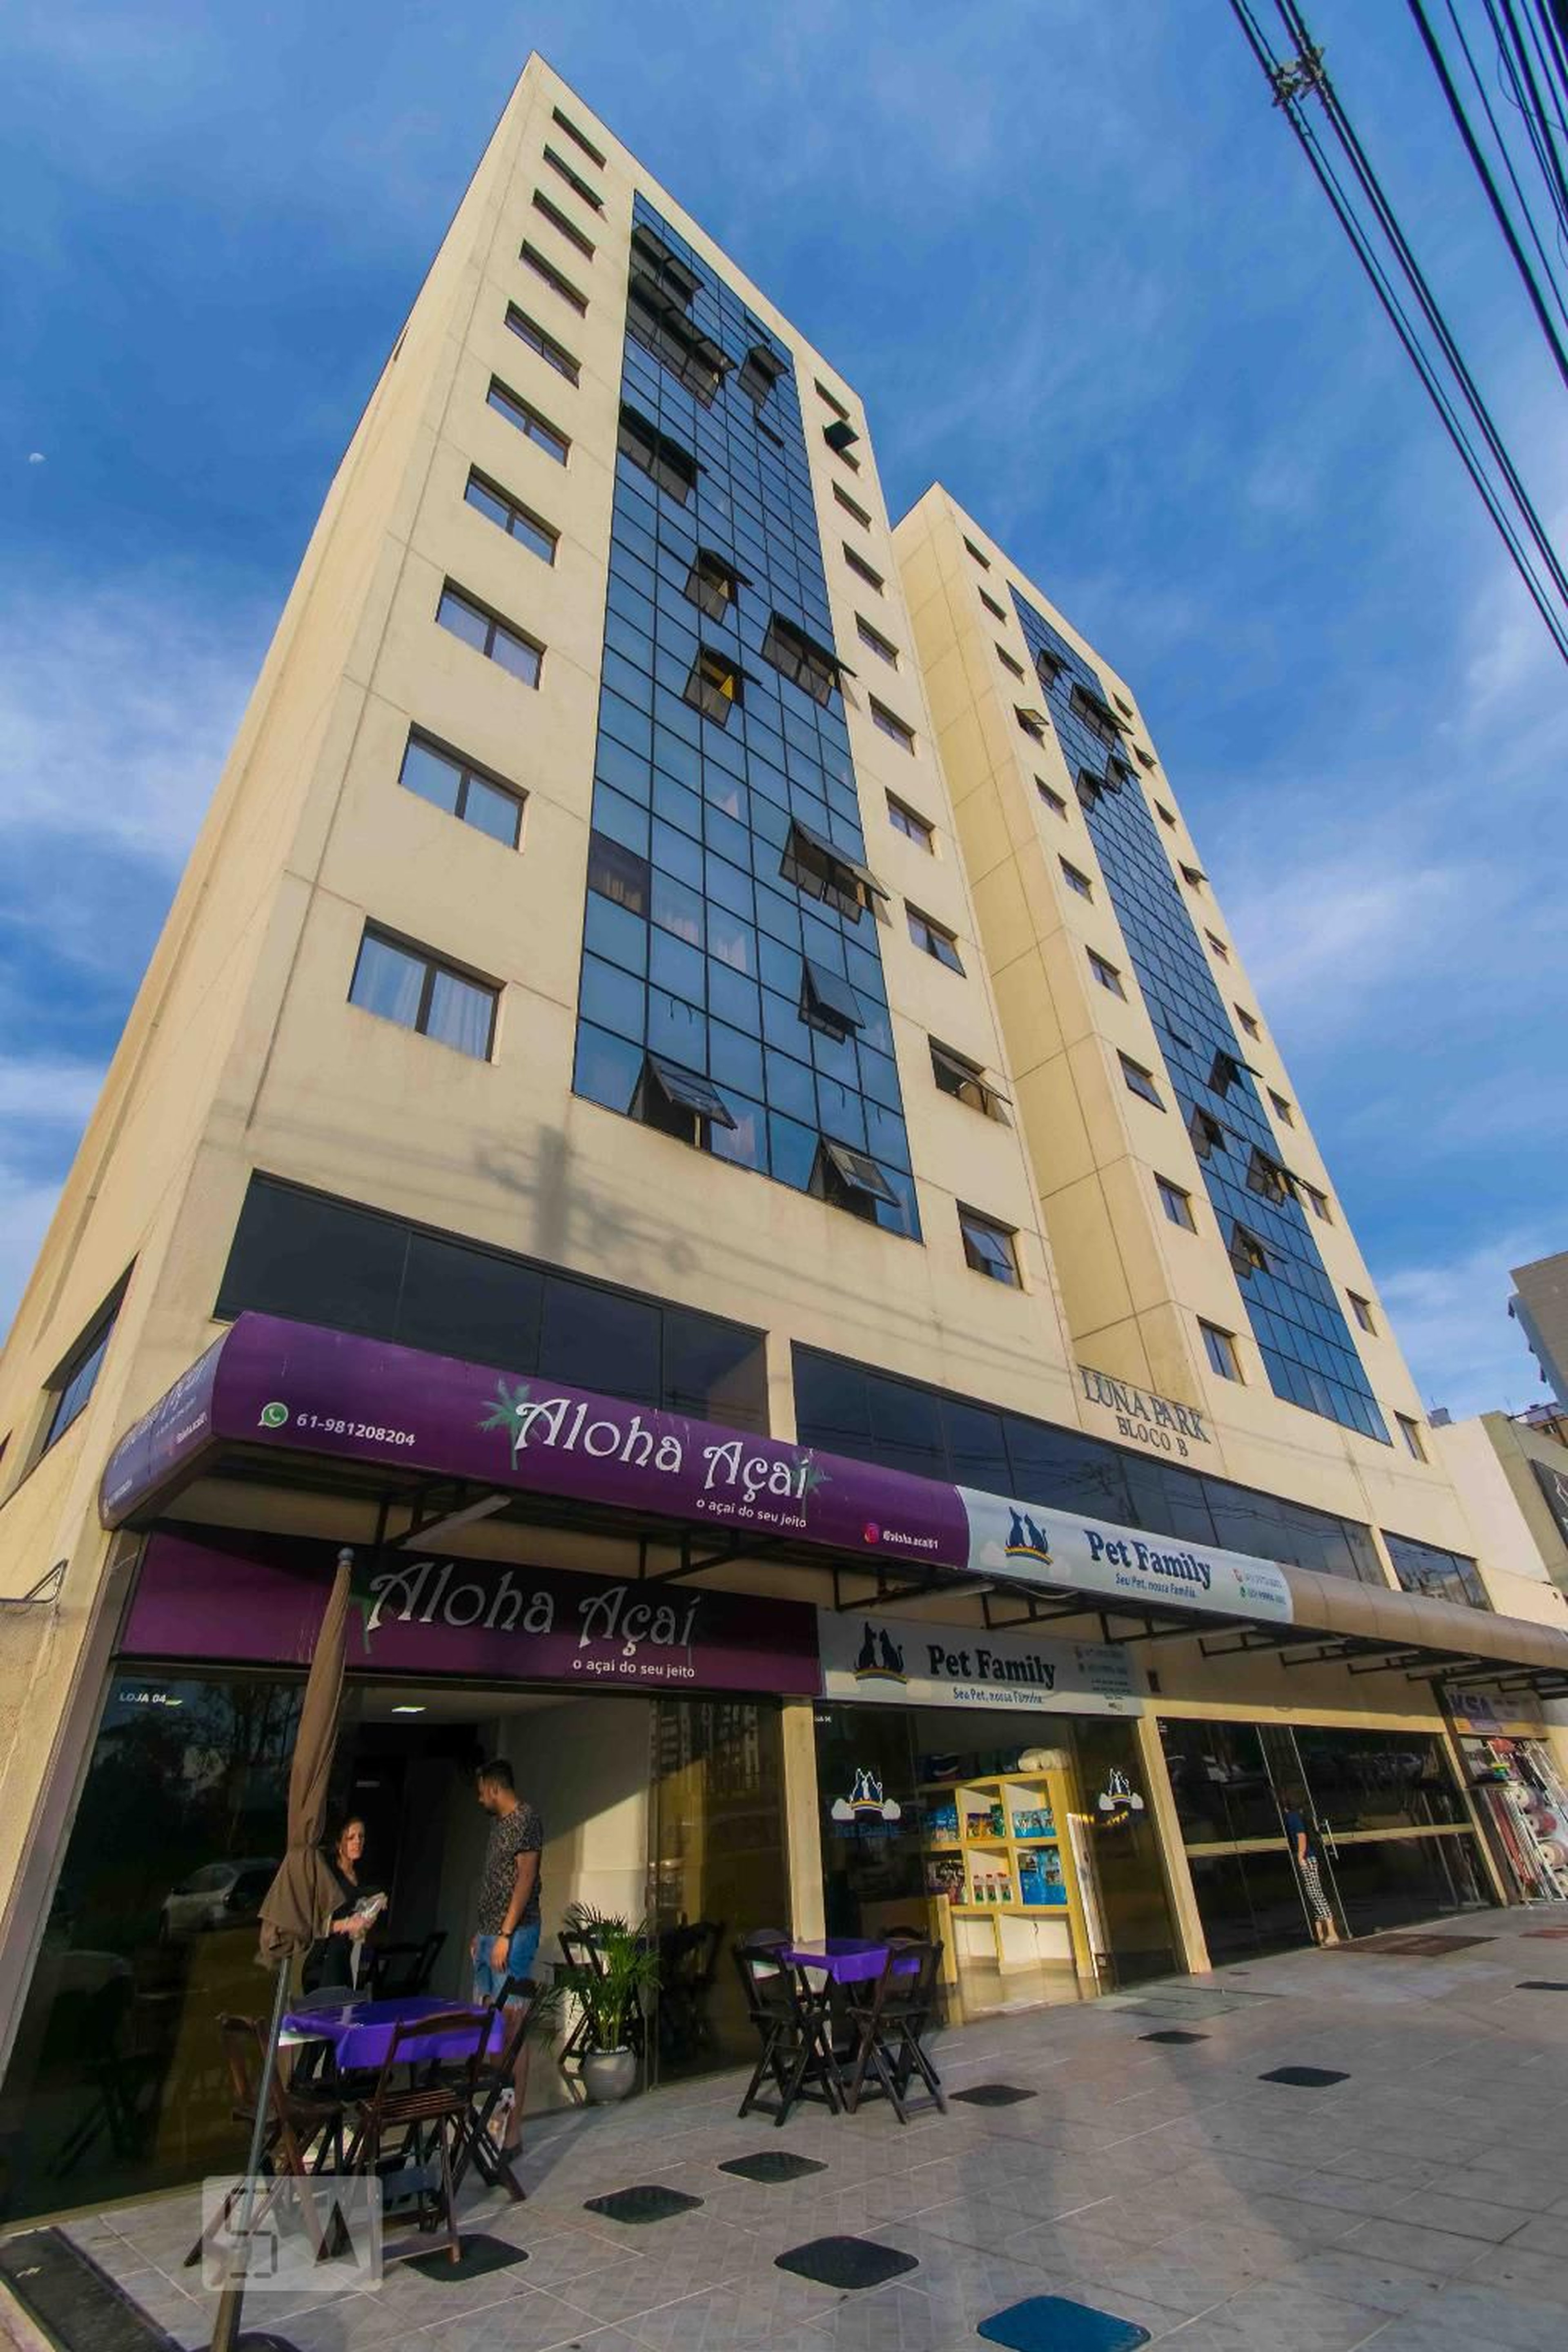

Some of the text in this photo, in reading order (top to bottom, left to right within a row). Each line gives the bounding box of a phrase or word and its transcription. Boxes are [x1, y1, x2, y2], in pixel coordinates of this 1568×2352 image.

[1080, 1370, 1211, 1444] LUNA PARK
[296, 1414, 416, 1446] 61-981208204
[515, 1399, 809, 1503] Aloha Açaí
[1116, 1415, 1188, 1457] BLOCO B
[696, 1499, 705, 1508] o
[738, 1506, 754, 1518] do
[757, 1510, 778, 1522] seu
[780, 1514, 806, 1527] jeito
[1083, 1529, 1210, 1590] Pet Family
[367, 1562, 701, 1656] Aloha Açaí
[573, 1660, 581, 1669] o
[619, 1661, 636, 1673] do
[641, 1665, 663, 1674] seu
[666, 1664, 695, 1678] jeito
[926, 1644, 1056, 1690] Pet Family
[119, 1693, 149, 1703] LOJA
